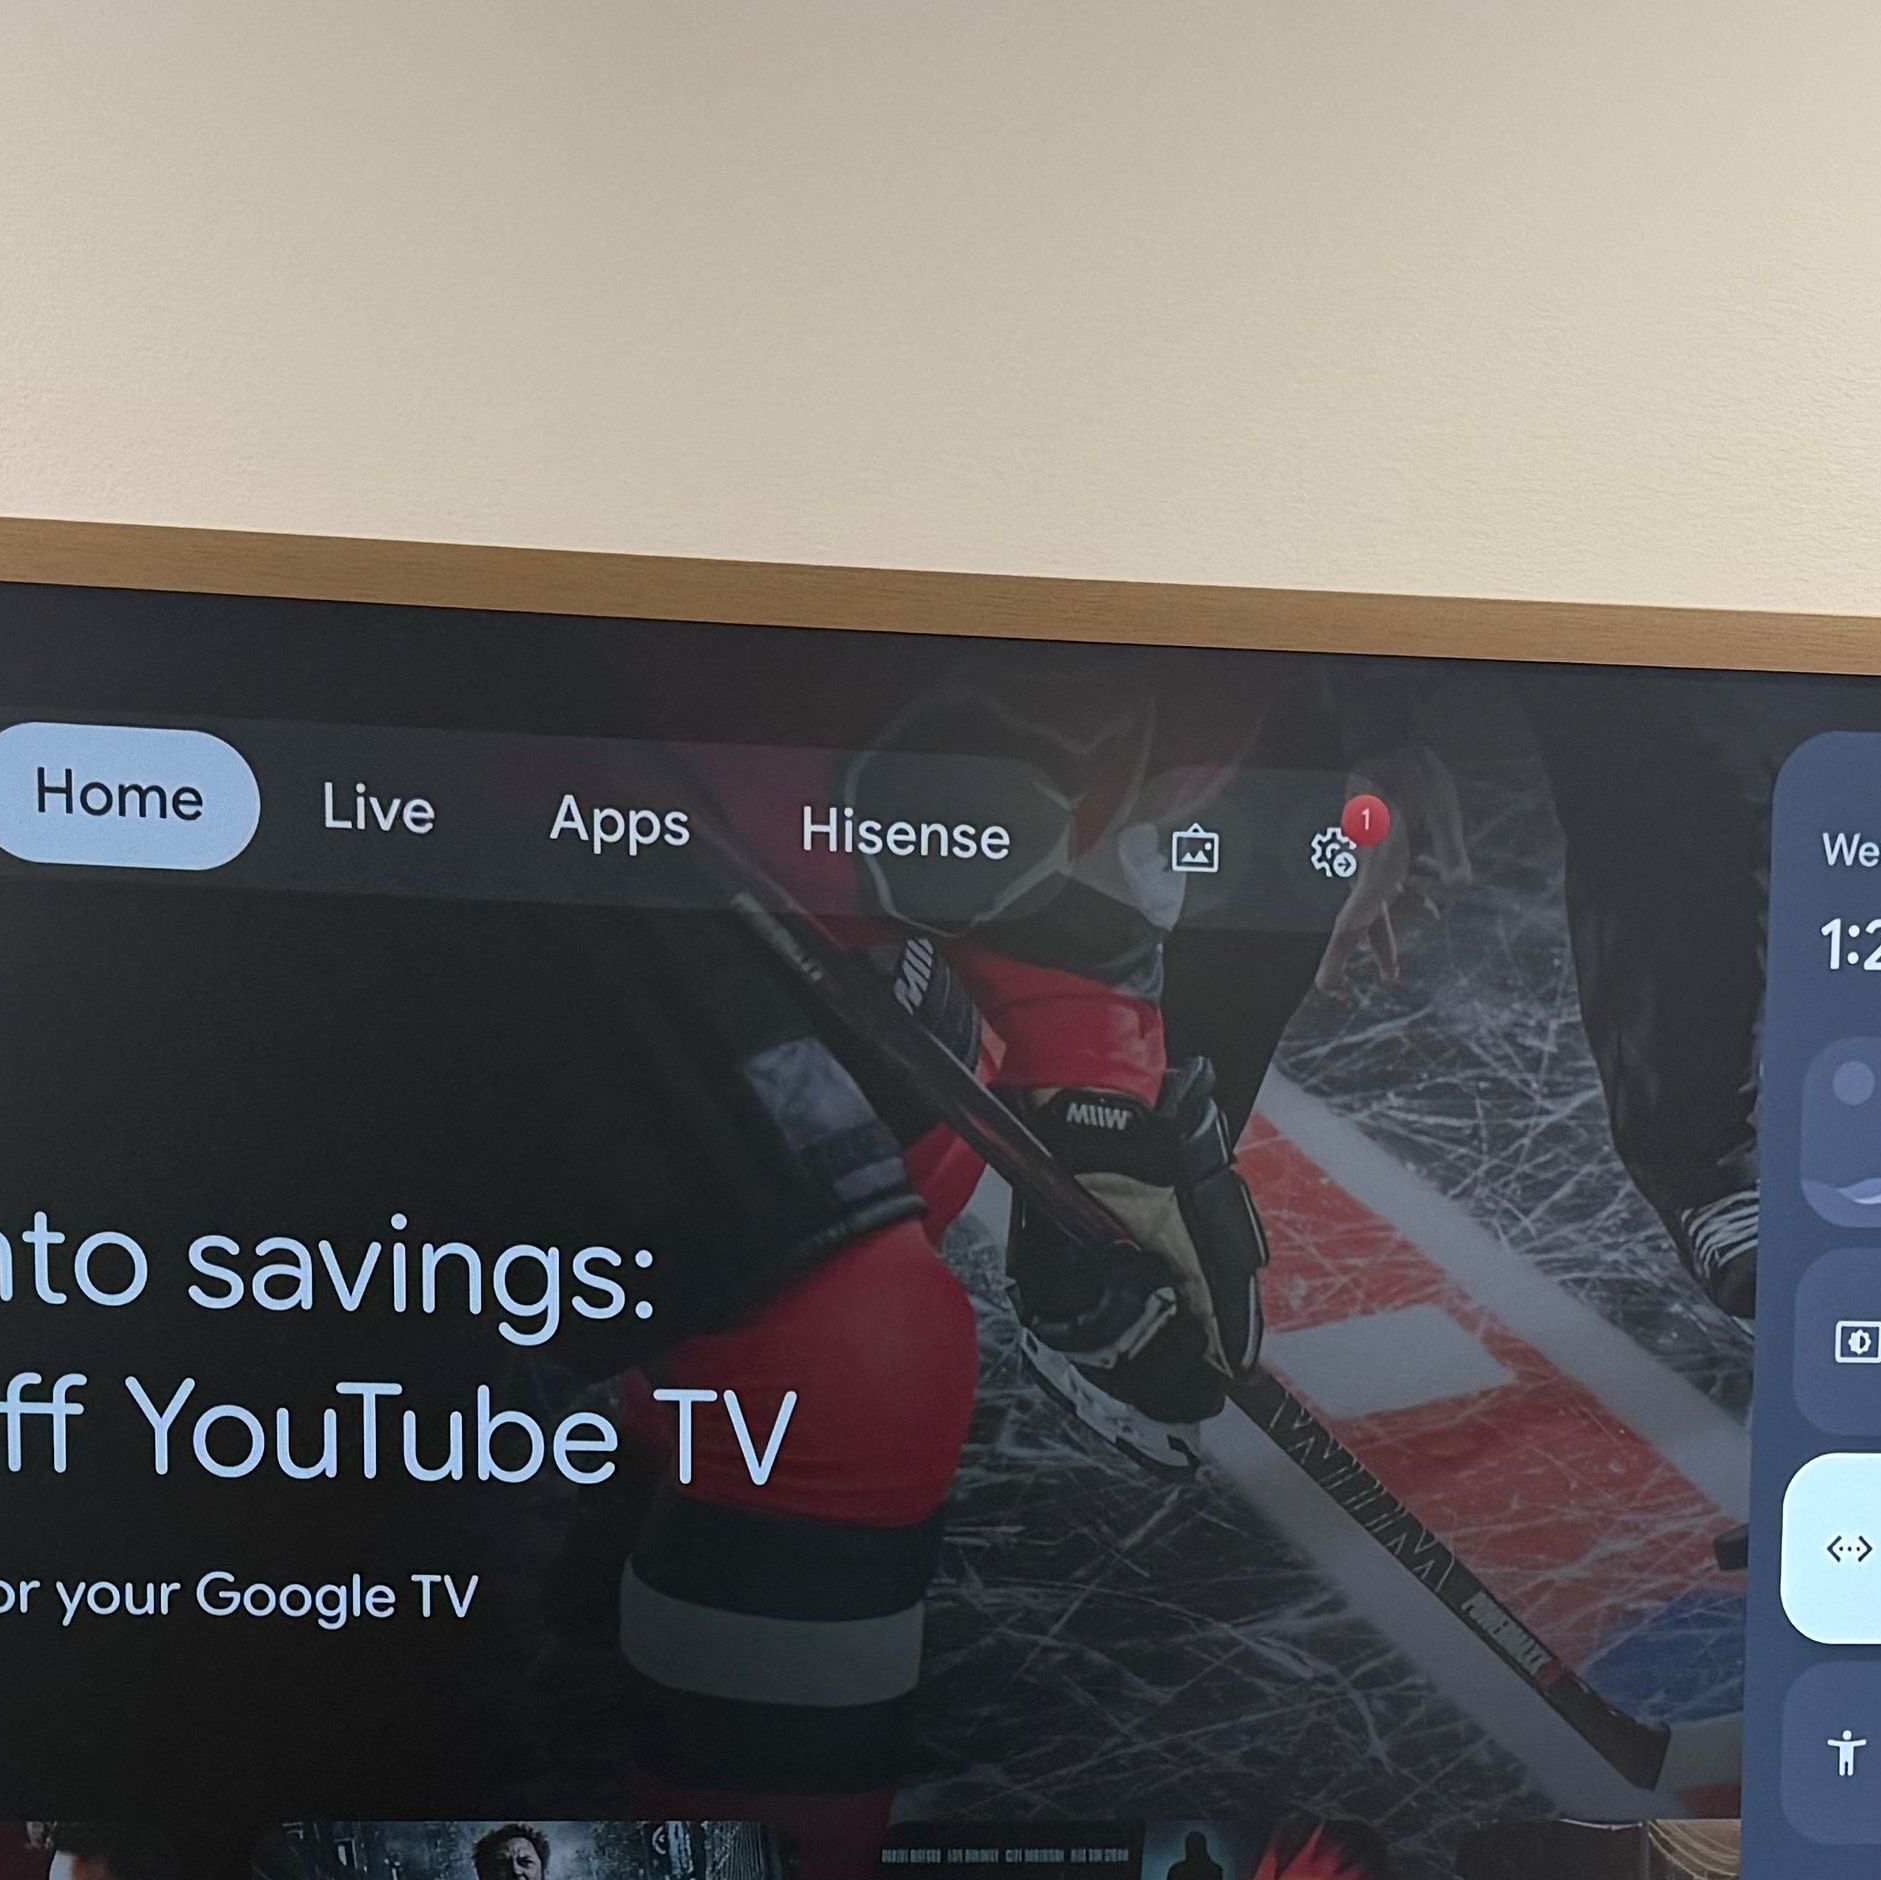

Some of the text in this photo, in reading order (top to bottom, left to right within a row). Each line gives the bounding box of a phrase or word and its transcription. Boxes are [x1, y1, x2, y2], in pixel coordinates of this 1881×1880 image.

[34, 764, 205, 822] Home
[322, 782, 436, 836] Live
[1360, 808, 1372, 832] 1
[549, 793, 692, 857] Apps
[802, 804, 1012, 862] Hisense
[186, 1213, 658, 1346] savings:
[125, 1376, 618, 1484] YouTube
[652, 1388, 798, 1486] TV
[55, 1578, 181, 1626] your
[195, 1572, 396, 1630] Google
[411, 1574, 480, 1618] TV
